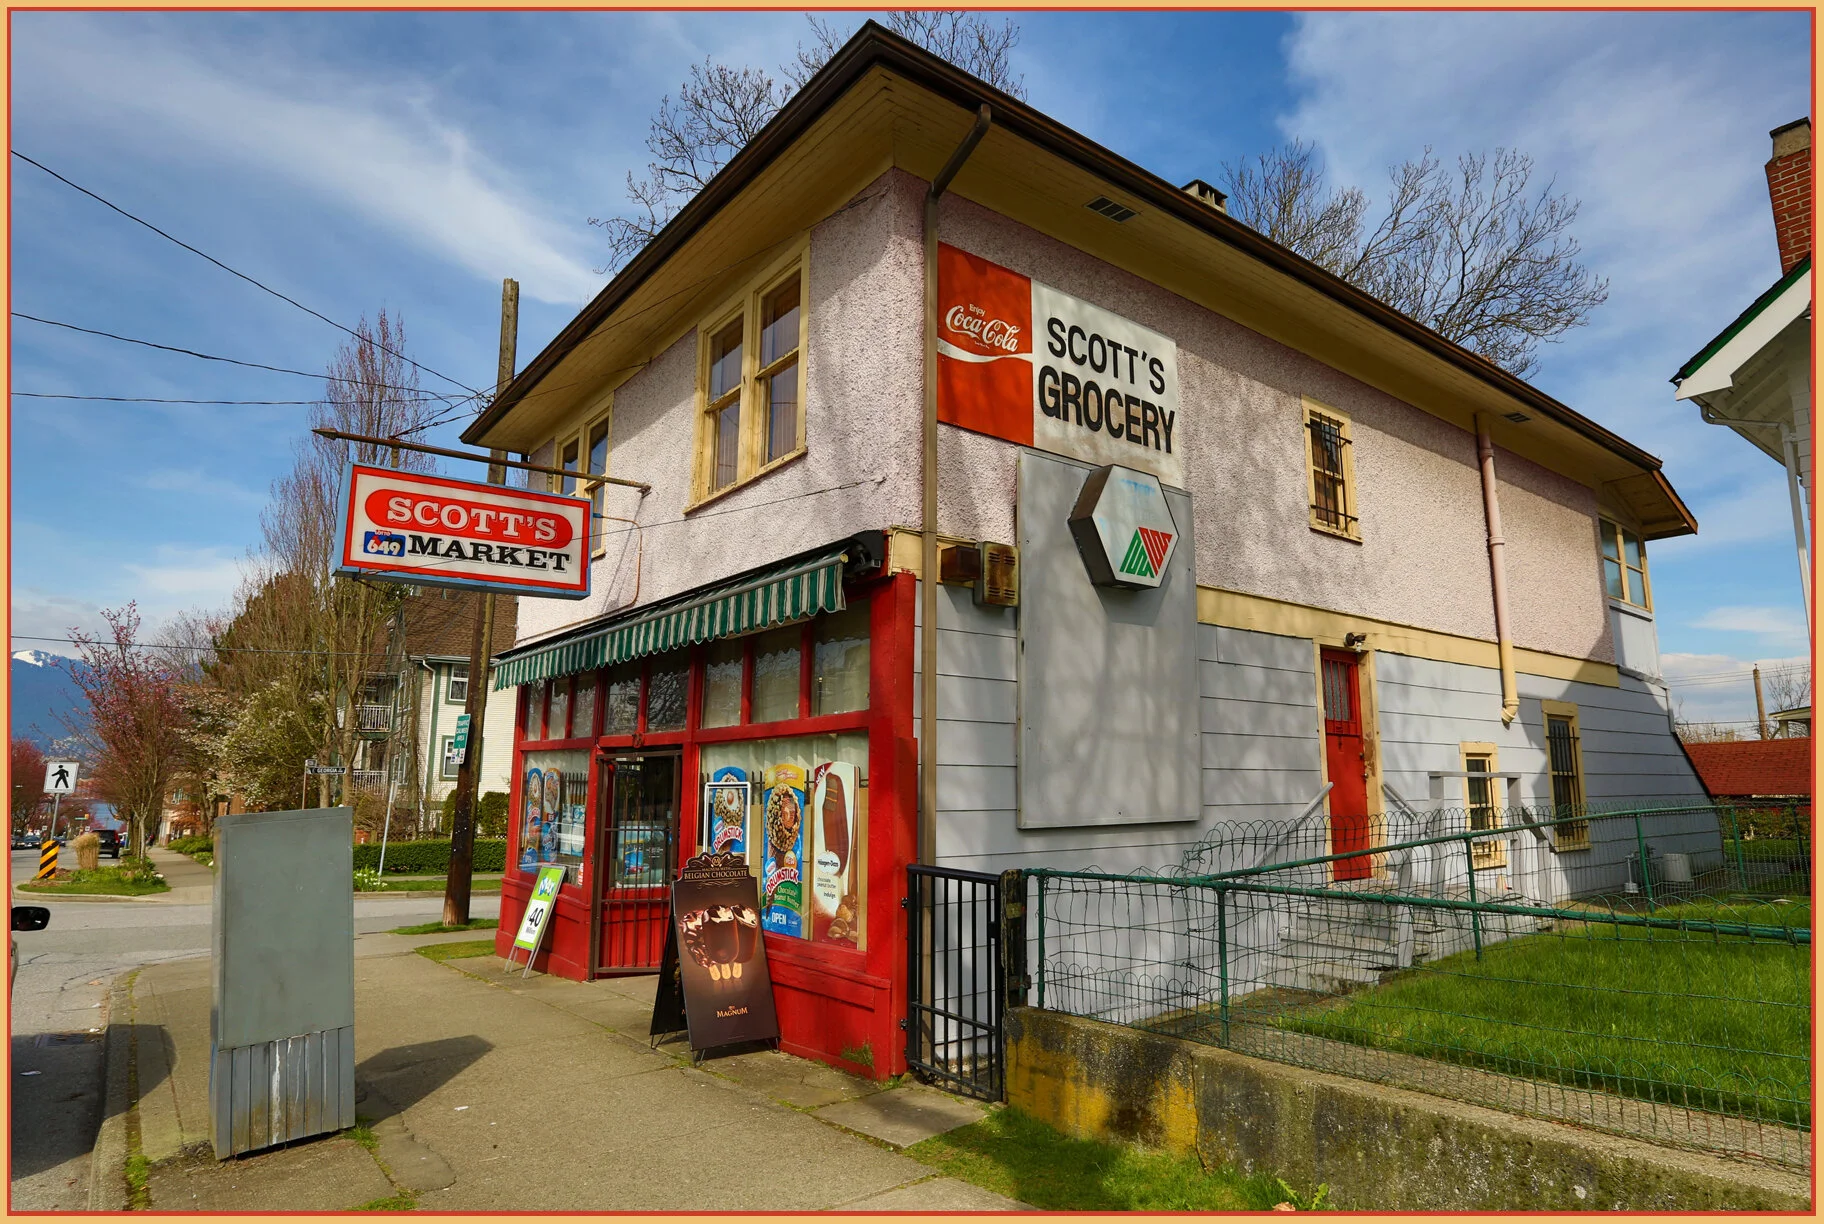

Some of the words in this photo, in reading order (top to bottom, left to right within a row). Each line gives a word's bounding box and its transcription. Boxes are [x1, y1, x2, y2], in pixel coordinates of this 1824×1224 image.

[969, 303, 986, 317] Enjoy
[1047, 317, 1166, 395] SCOTT'S
[1038, 365, 1175, 454] GROCERY
[387, 496, 557, 542] SCOTT'S
[367, 535, 402, 556] 649
[407, 534, 572, 573] MARKET
[684, 872, 710, 880] BELGIAN
[711, 870, 747, 878] CHOCOLATE
[765, 867, 799, 896] DRUMSTICK
[771, 912, 787, 925] OPEN
[716, 1006, 748, 1018] MAGNUM
